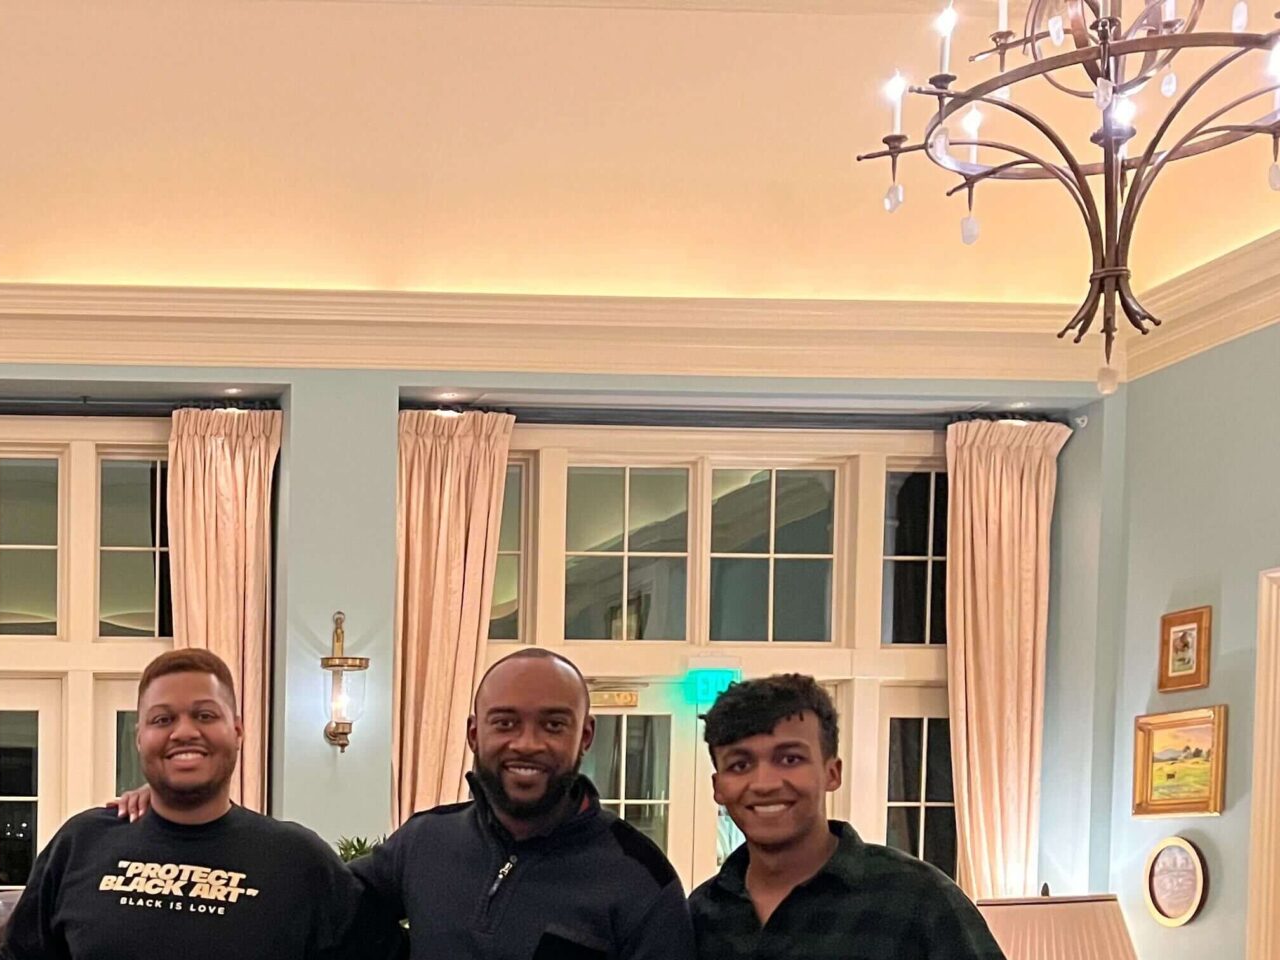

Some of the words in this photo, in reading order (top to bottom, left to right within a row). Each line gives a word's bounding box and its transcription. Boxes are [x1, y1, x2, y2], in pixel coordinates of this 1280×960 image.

[118, 860, 246, 887] "PROTECT
[99, 875, 188, 896] BLACK
[189, 883, 259, 903] ART"
[120, 897, 162, 908] BLACK
[170, 902, 183, 910] IS
[190, 903, 225, 915] LOVE
